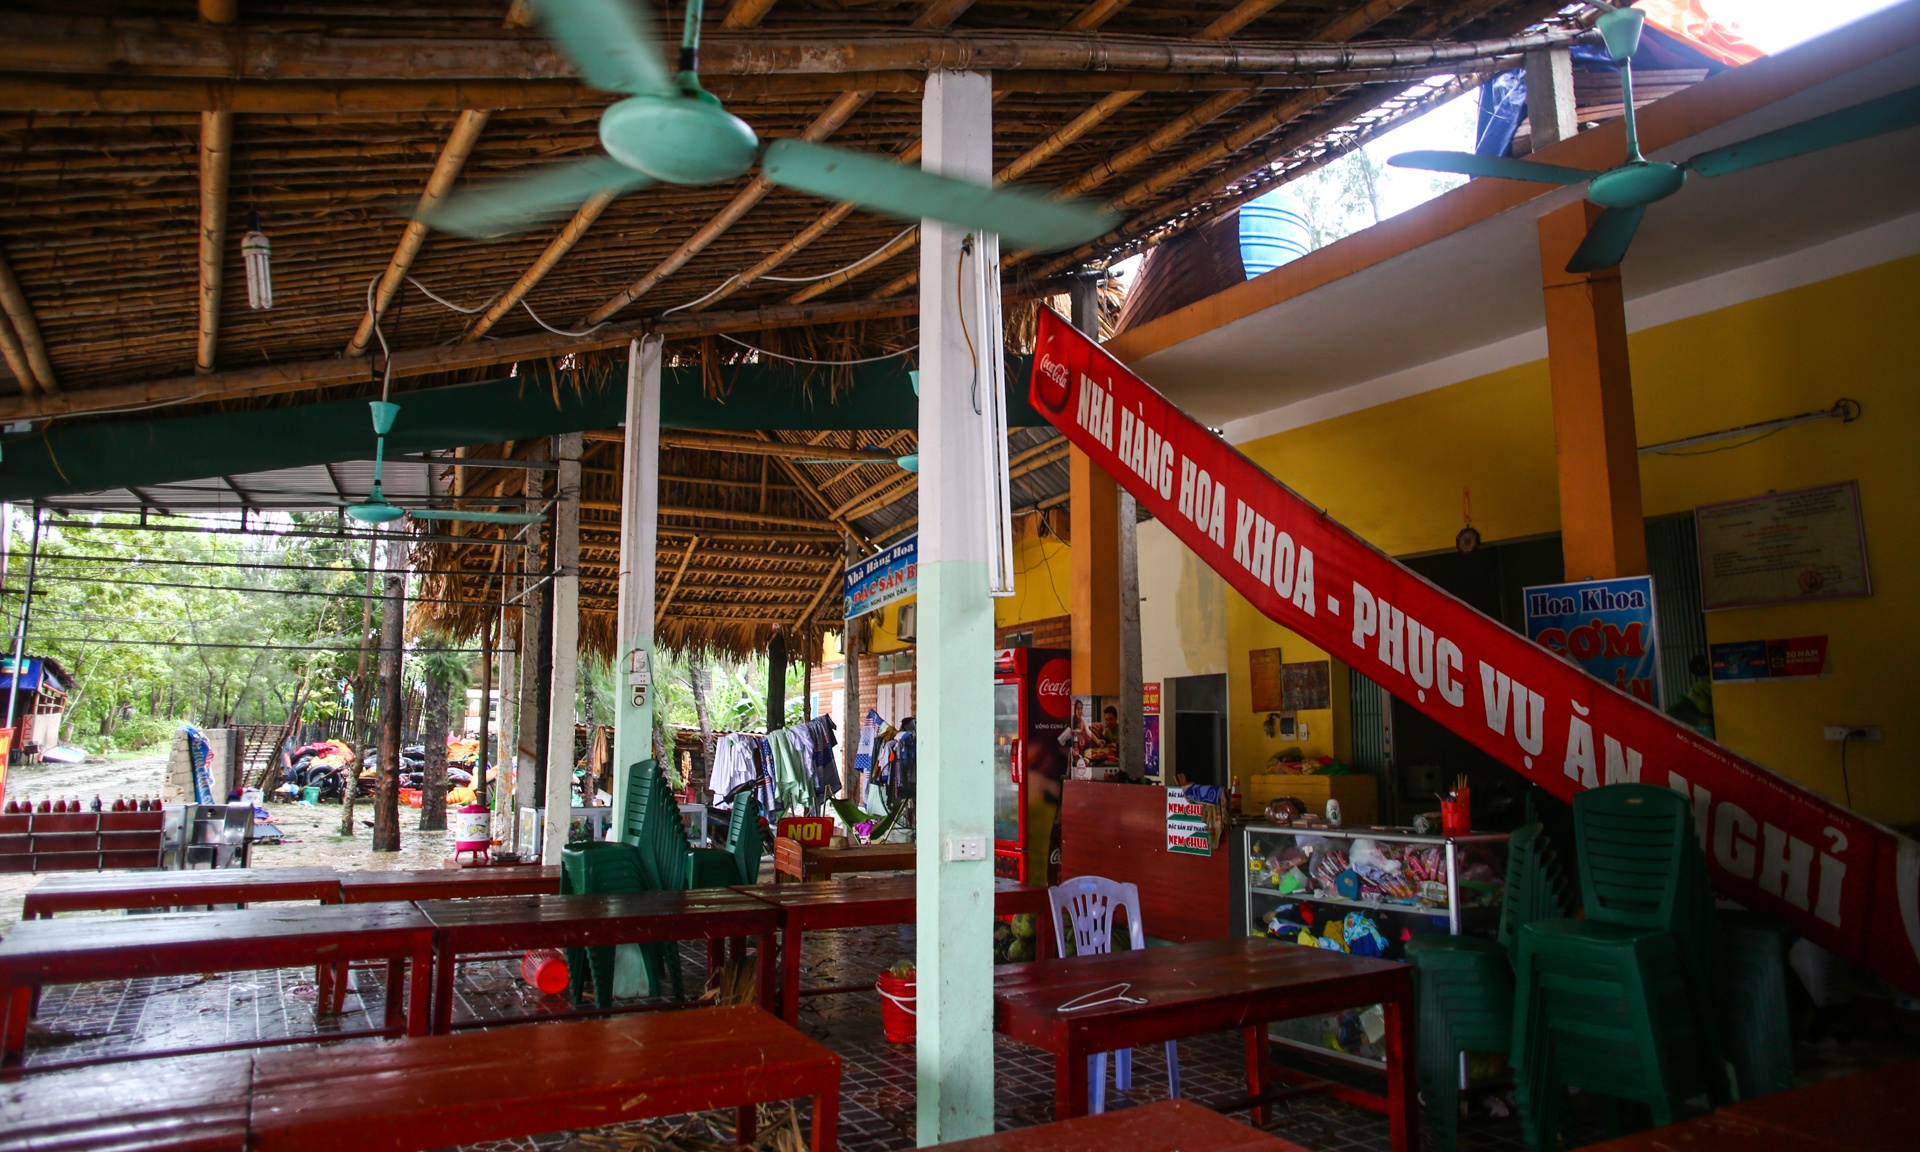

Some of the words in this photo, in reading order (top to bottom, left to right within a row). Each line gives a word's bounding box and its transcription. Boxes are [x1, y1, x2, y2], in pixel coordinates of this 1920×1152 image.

[1039, 353, 1069, 389] Coca-Cola
[847, 568, 864, 588] Nhà
[866, 553, 891, 575] Hàng
[893, 544, 914, 559] Hoa
[1077, 373, 1113, 452] NHÀ
[1118, 402, 1174, 501] HÀNG
[1178, 454, 1226, 549] HOA
[1233, 498, 1316, 618] KHOA
[1352, 580, 1464, 708] PHỤC
[1479, 660, 1545, 770] VỤ
[854, 582, 876, 603] ĐẶC
[879, 567, 904, 592] SẢN
[1530, 593, 1576, 618] Hoa
[1580, 587, 1646, 613] Khoa
[1535, 618, 1646, 660] CƠM
[1168, 803, 1184, 814] NEM
[788, 822, 822, 840] NƠI
[1168, 835, 1184, 846] NEM
[1186, 836, 1208, 849] CHUA
[1177, 823, 1186, 831] SẢN
